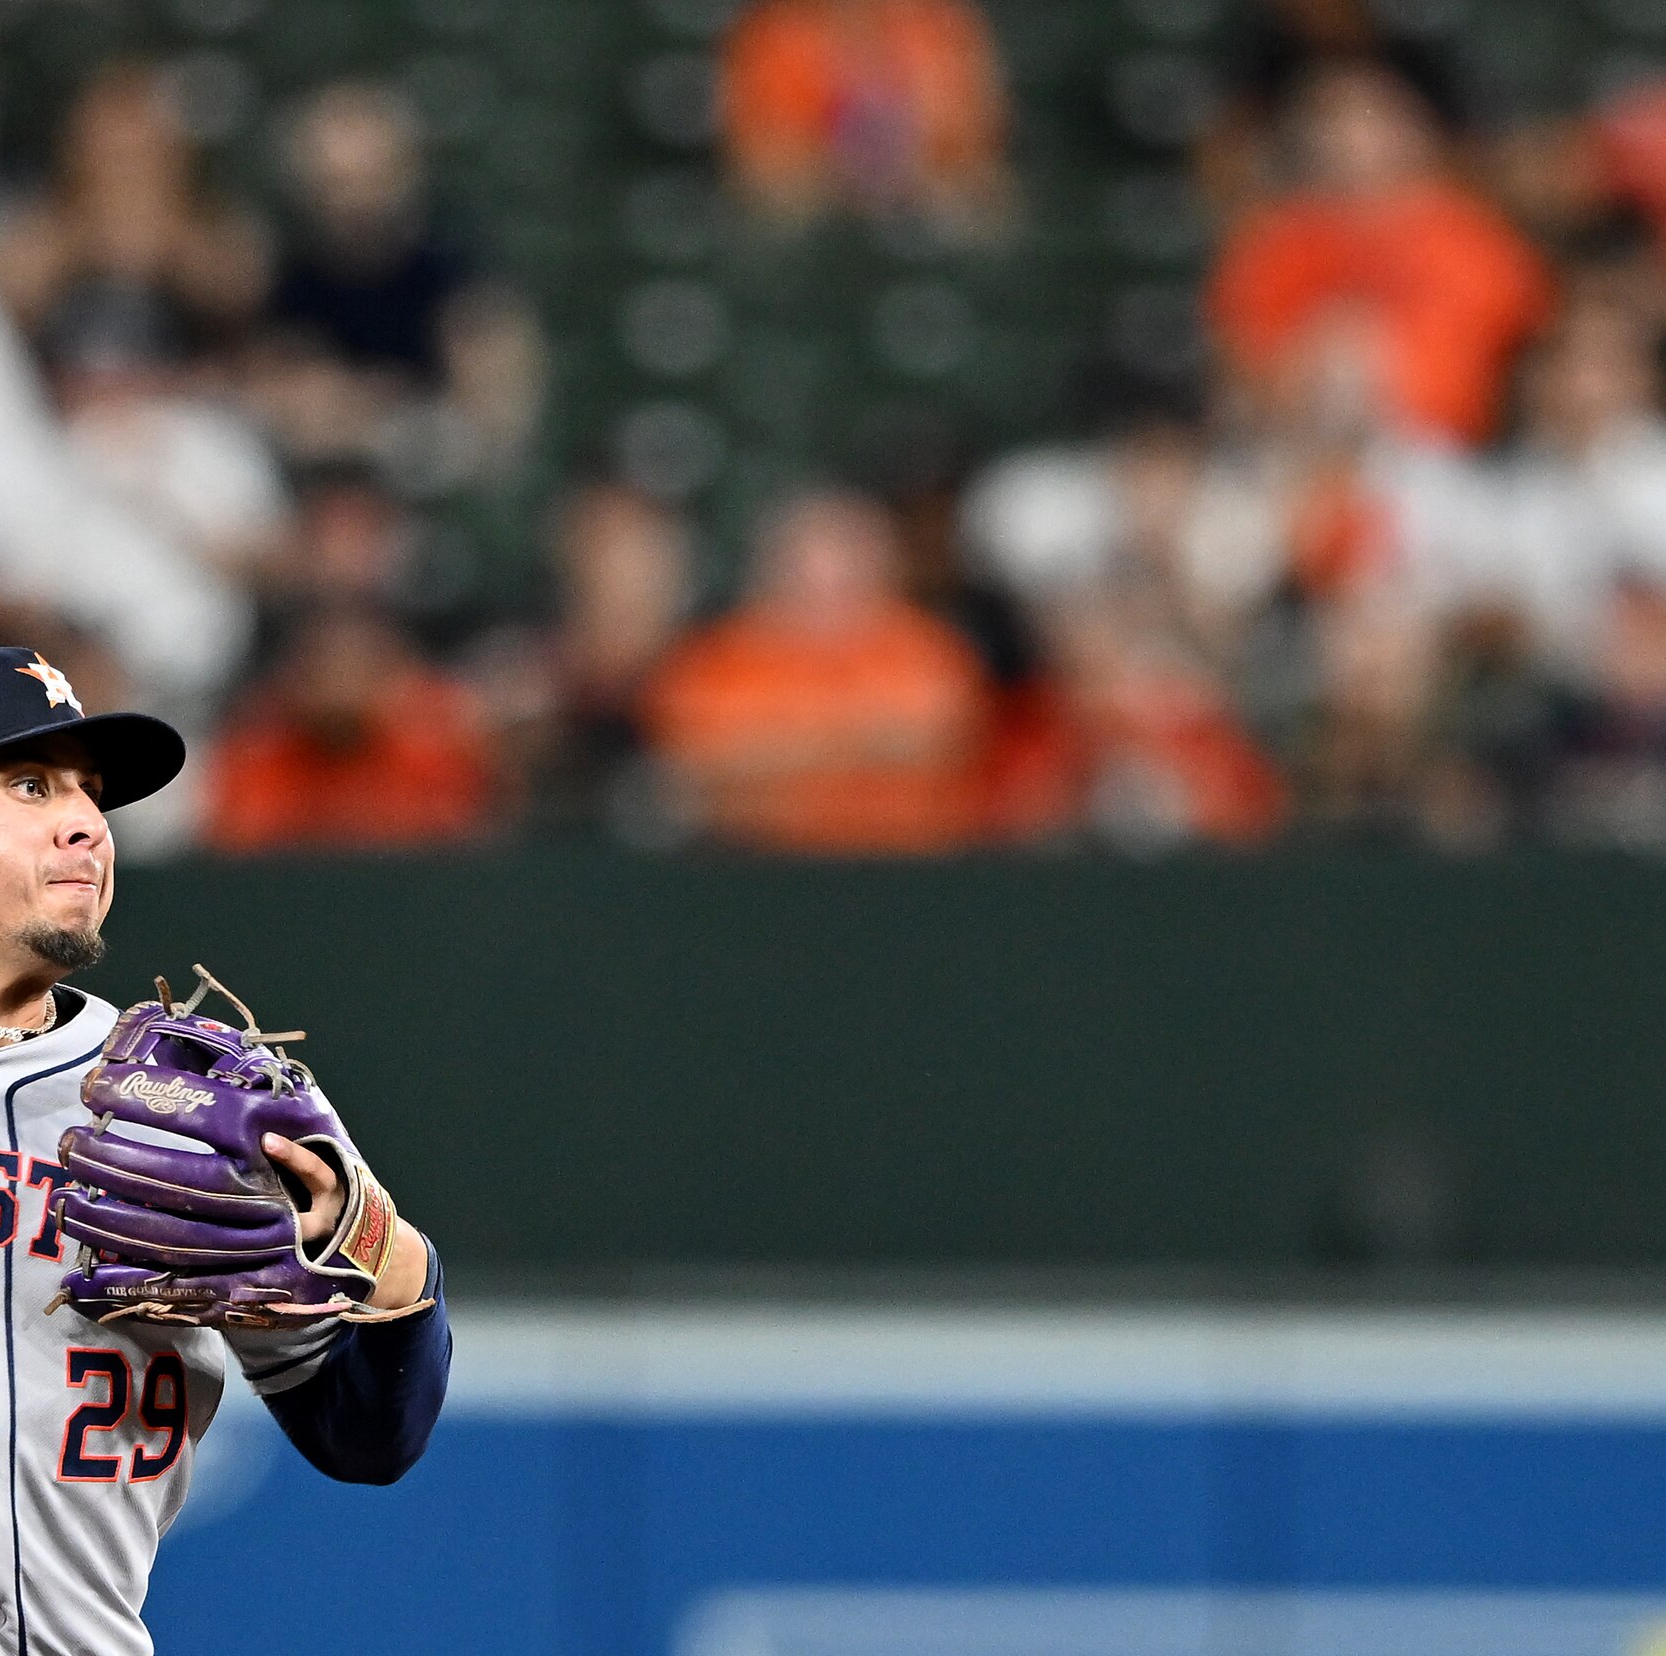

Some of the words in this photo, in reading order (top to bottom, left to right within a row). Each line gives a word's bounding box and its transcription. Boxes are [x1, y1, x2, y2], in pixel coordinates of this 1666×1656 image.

[119, 1070, 216, 1113] Rawlings
[105, 1286, 128, 1297] THE
[56, 1347, 187, 1483] 29
